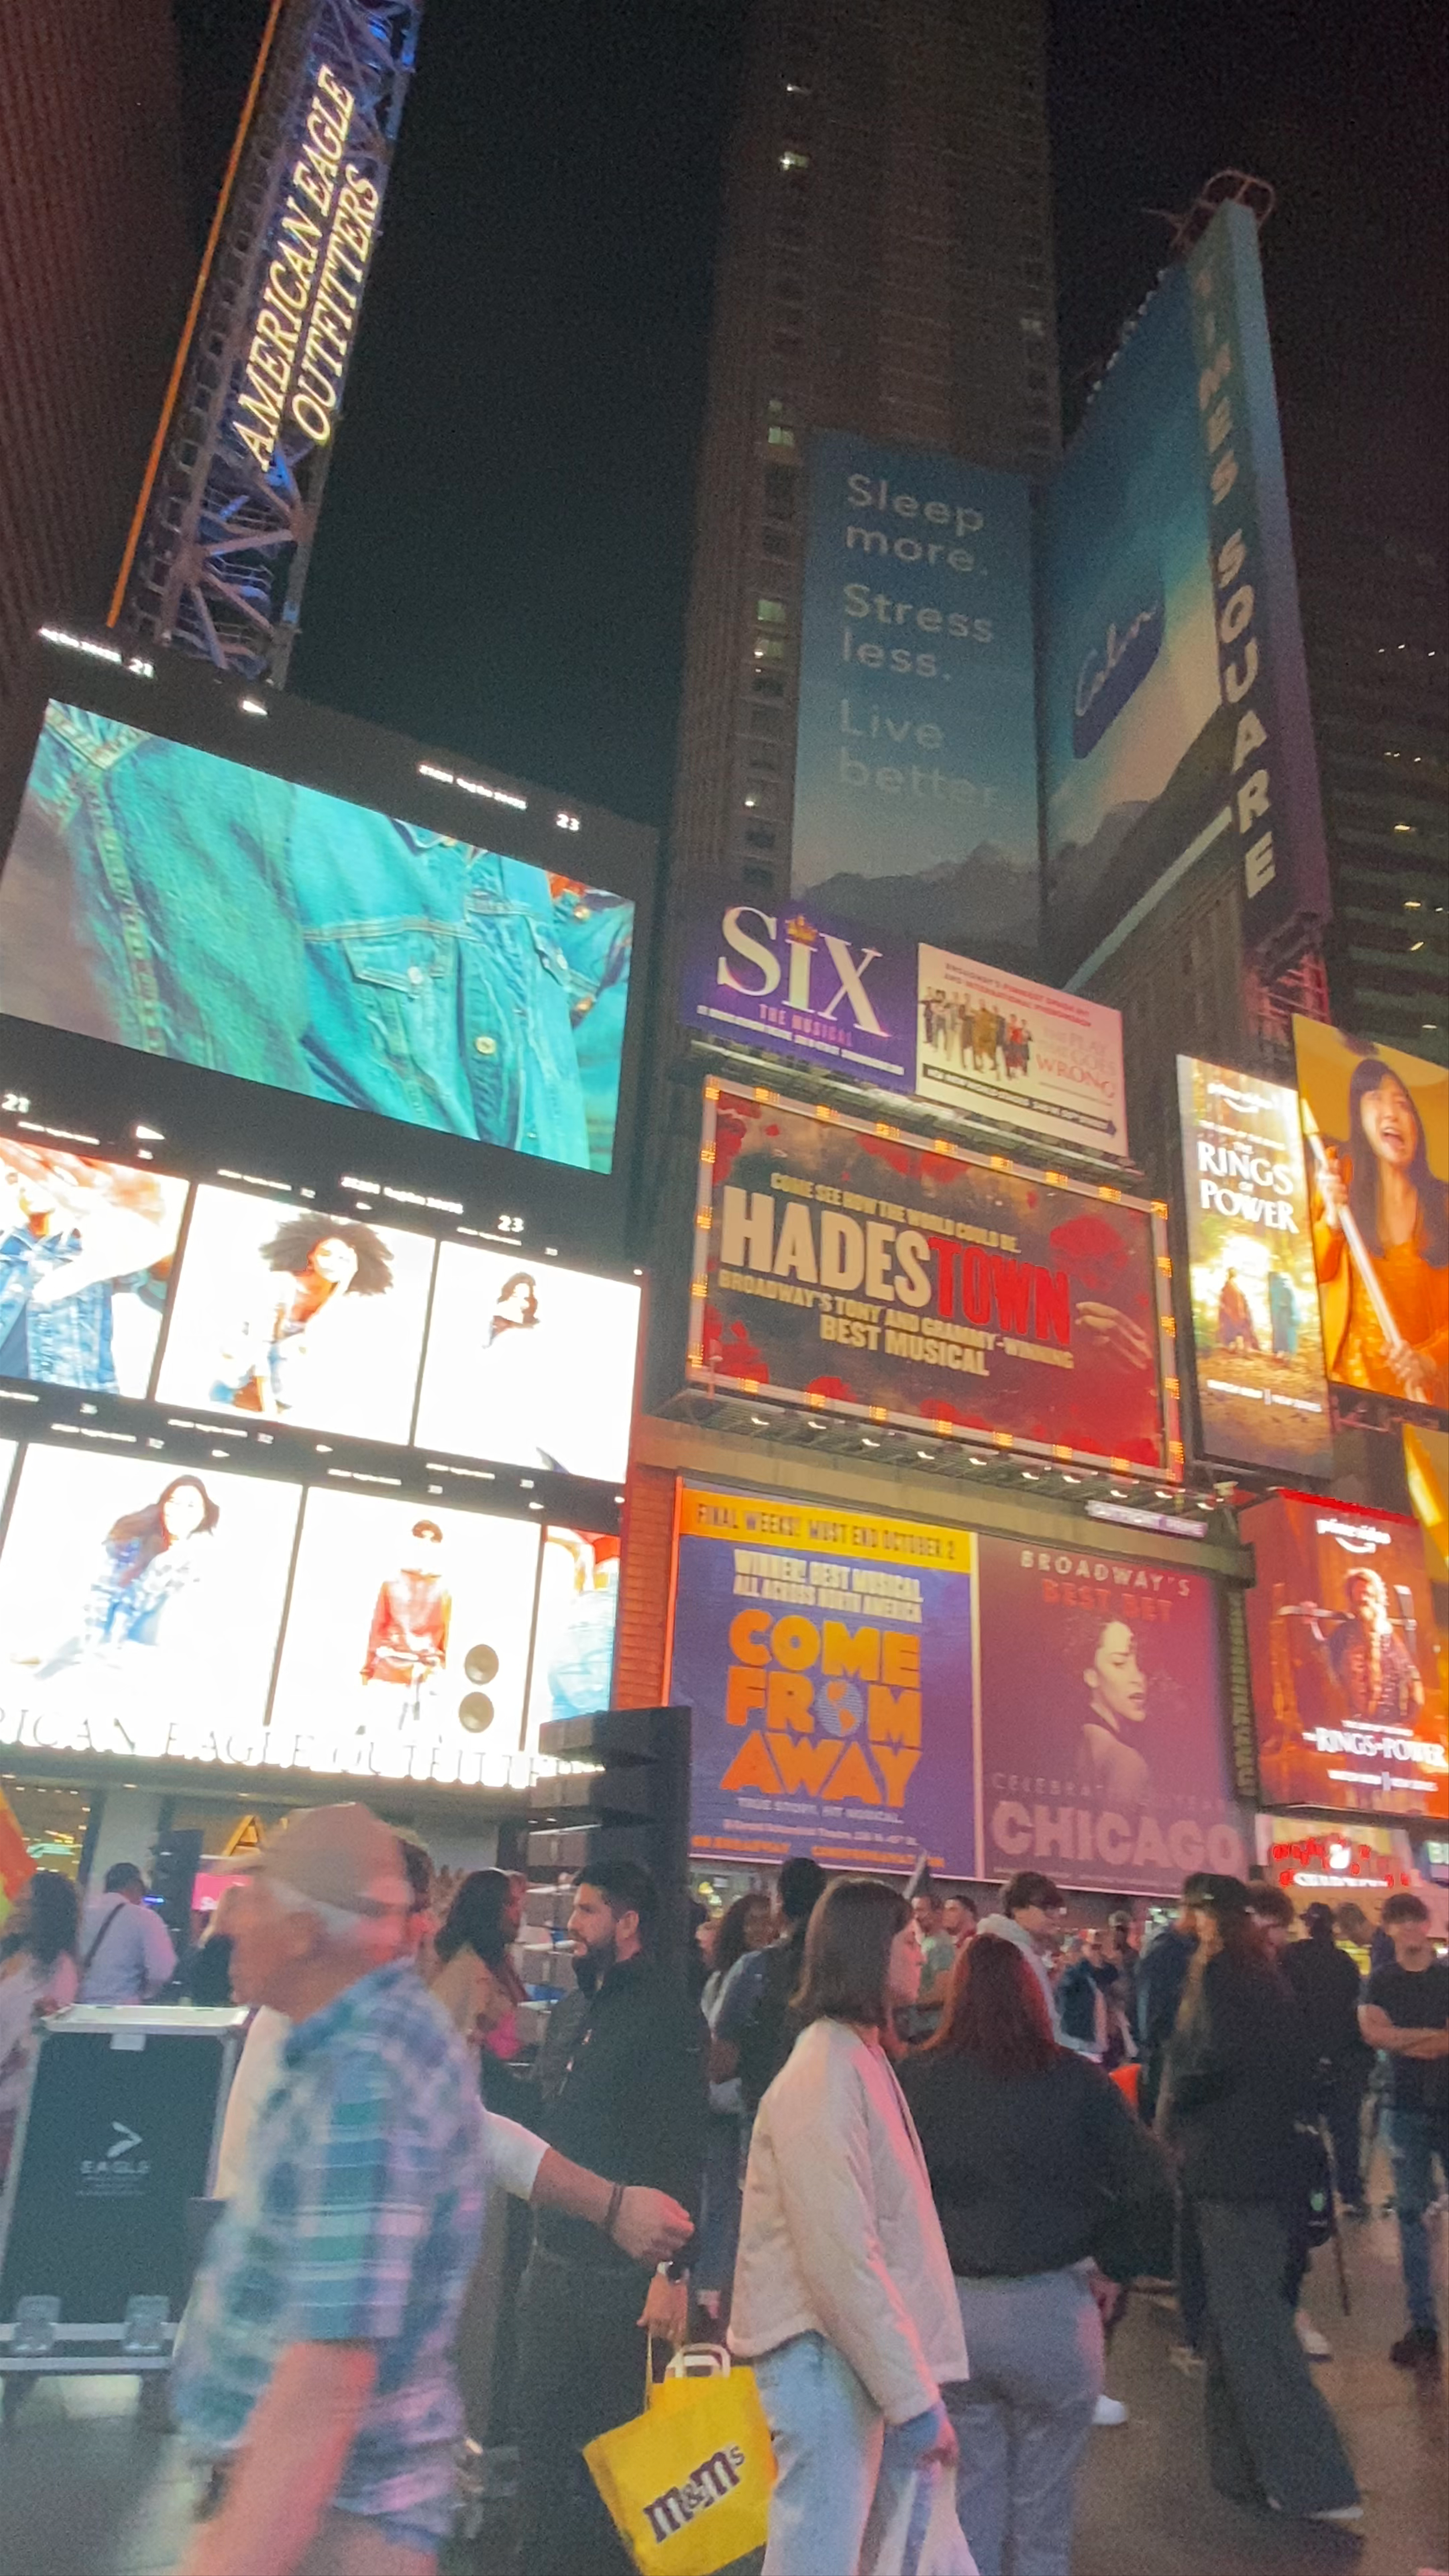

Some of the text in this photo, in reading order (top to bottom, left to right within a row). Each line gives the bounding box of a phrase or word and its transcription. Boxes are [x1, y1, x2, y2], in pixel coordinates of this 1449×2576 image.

[232, 64, 355, 472] AMERICAN EAGLE
[292, 164, 378, 446] OUTFITTERS
[848, 473, 983, 536] Sleep
[845, 526, 988, 575] more.
[843, 583, 994, 643] Stress
[843, 627, 951, 681] less.
[840, 699, 945, 749] Live
[718, 906, 891, 1038] SIX
[1197, 1141, 1294, 1195] RINGS
[1199, 1179, 1300, 1234] POWER
[718, 1269, 833, 1313] BROADWAY'S
[820, 1314, 989, 1376] BEST MUSICAL
[1021, 1550, 1191, 1597] BROADWAY'S
[1042, 1578, 1111, 1613] BEST
[728, 1609, 921, 1687] COME
[726, 1666, 922, 1747] FROM
[720, 1730, 922, 1807] AWAY
[992, 1799, 1247, 1876] CHICAGO
